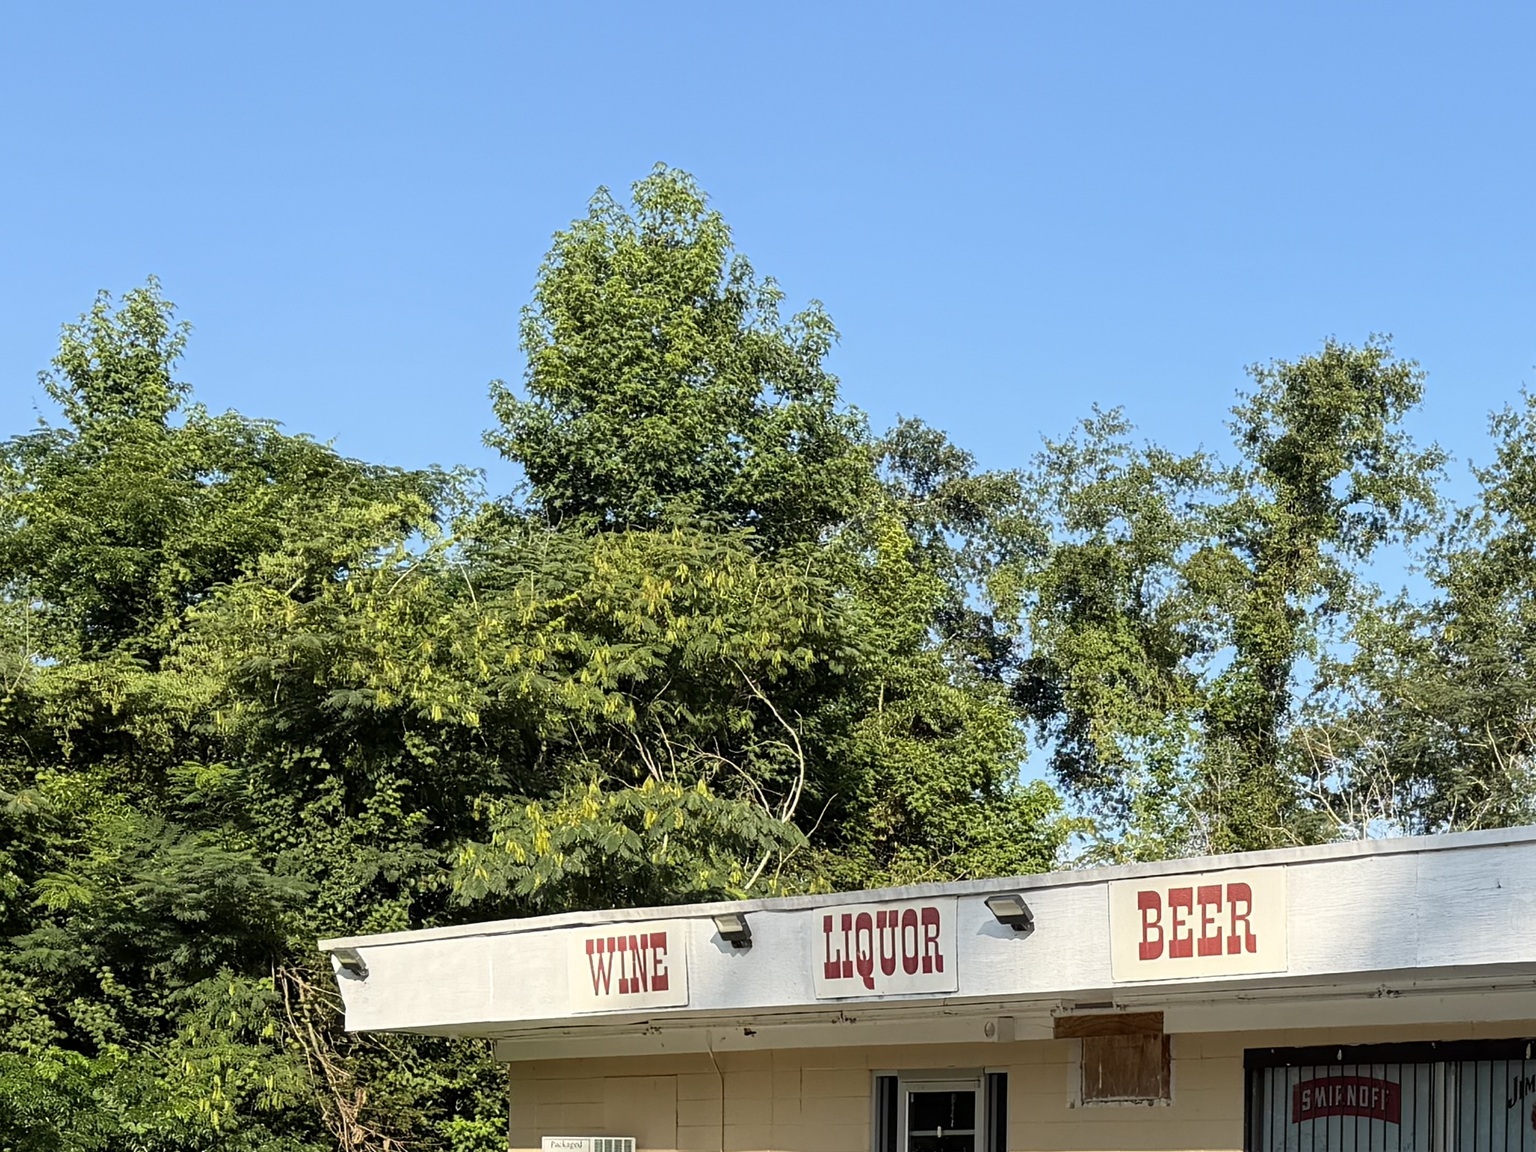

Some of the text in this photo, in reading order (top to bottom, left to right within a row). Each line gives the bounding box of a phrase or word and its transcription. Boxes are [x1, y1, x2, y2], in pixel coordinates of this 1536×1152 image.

[822, 906, 944, 991] LIQUOR
[1137, 882, 1257, 961] BEER
[585, 931, 670, 996] WINE
[550, 1140, 583, 1149] Packaged
